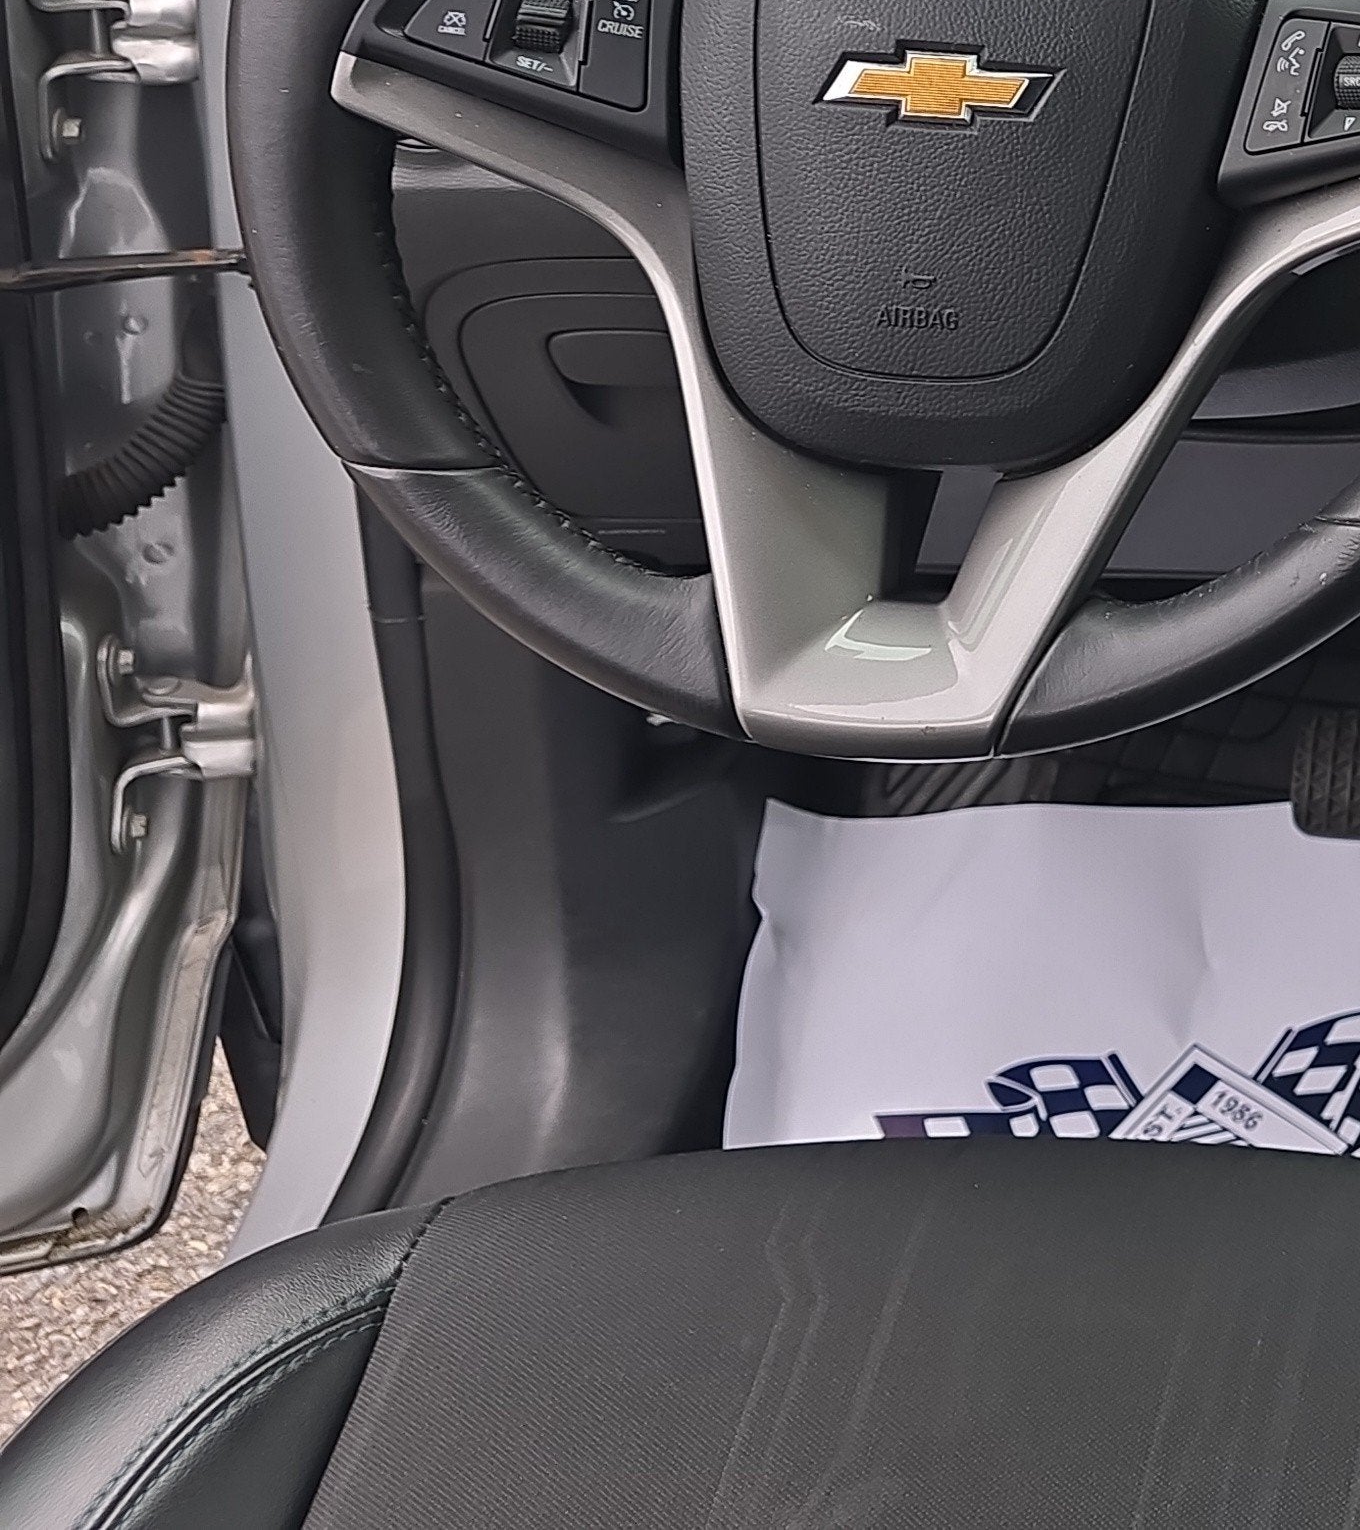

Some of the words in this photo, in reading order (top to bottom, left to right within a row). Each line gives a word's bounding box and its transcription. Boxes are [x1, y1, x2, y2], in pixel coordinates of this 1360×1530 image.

[597, 19, 644, 39] CRUISE
[877, 306, 960, 330] AIRBAG
[1210, 1089, 1263, 1130] 1986
